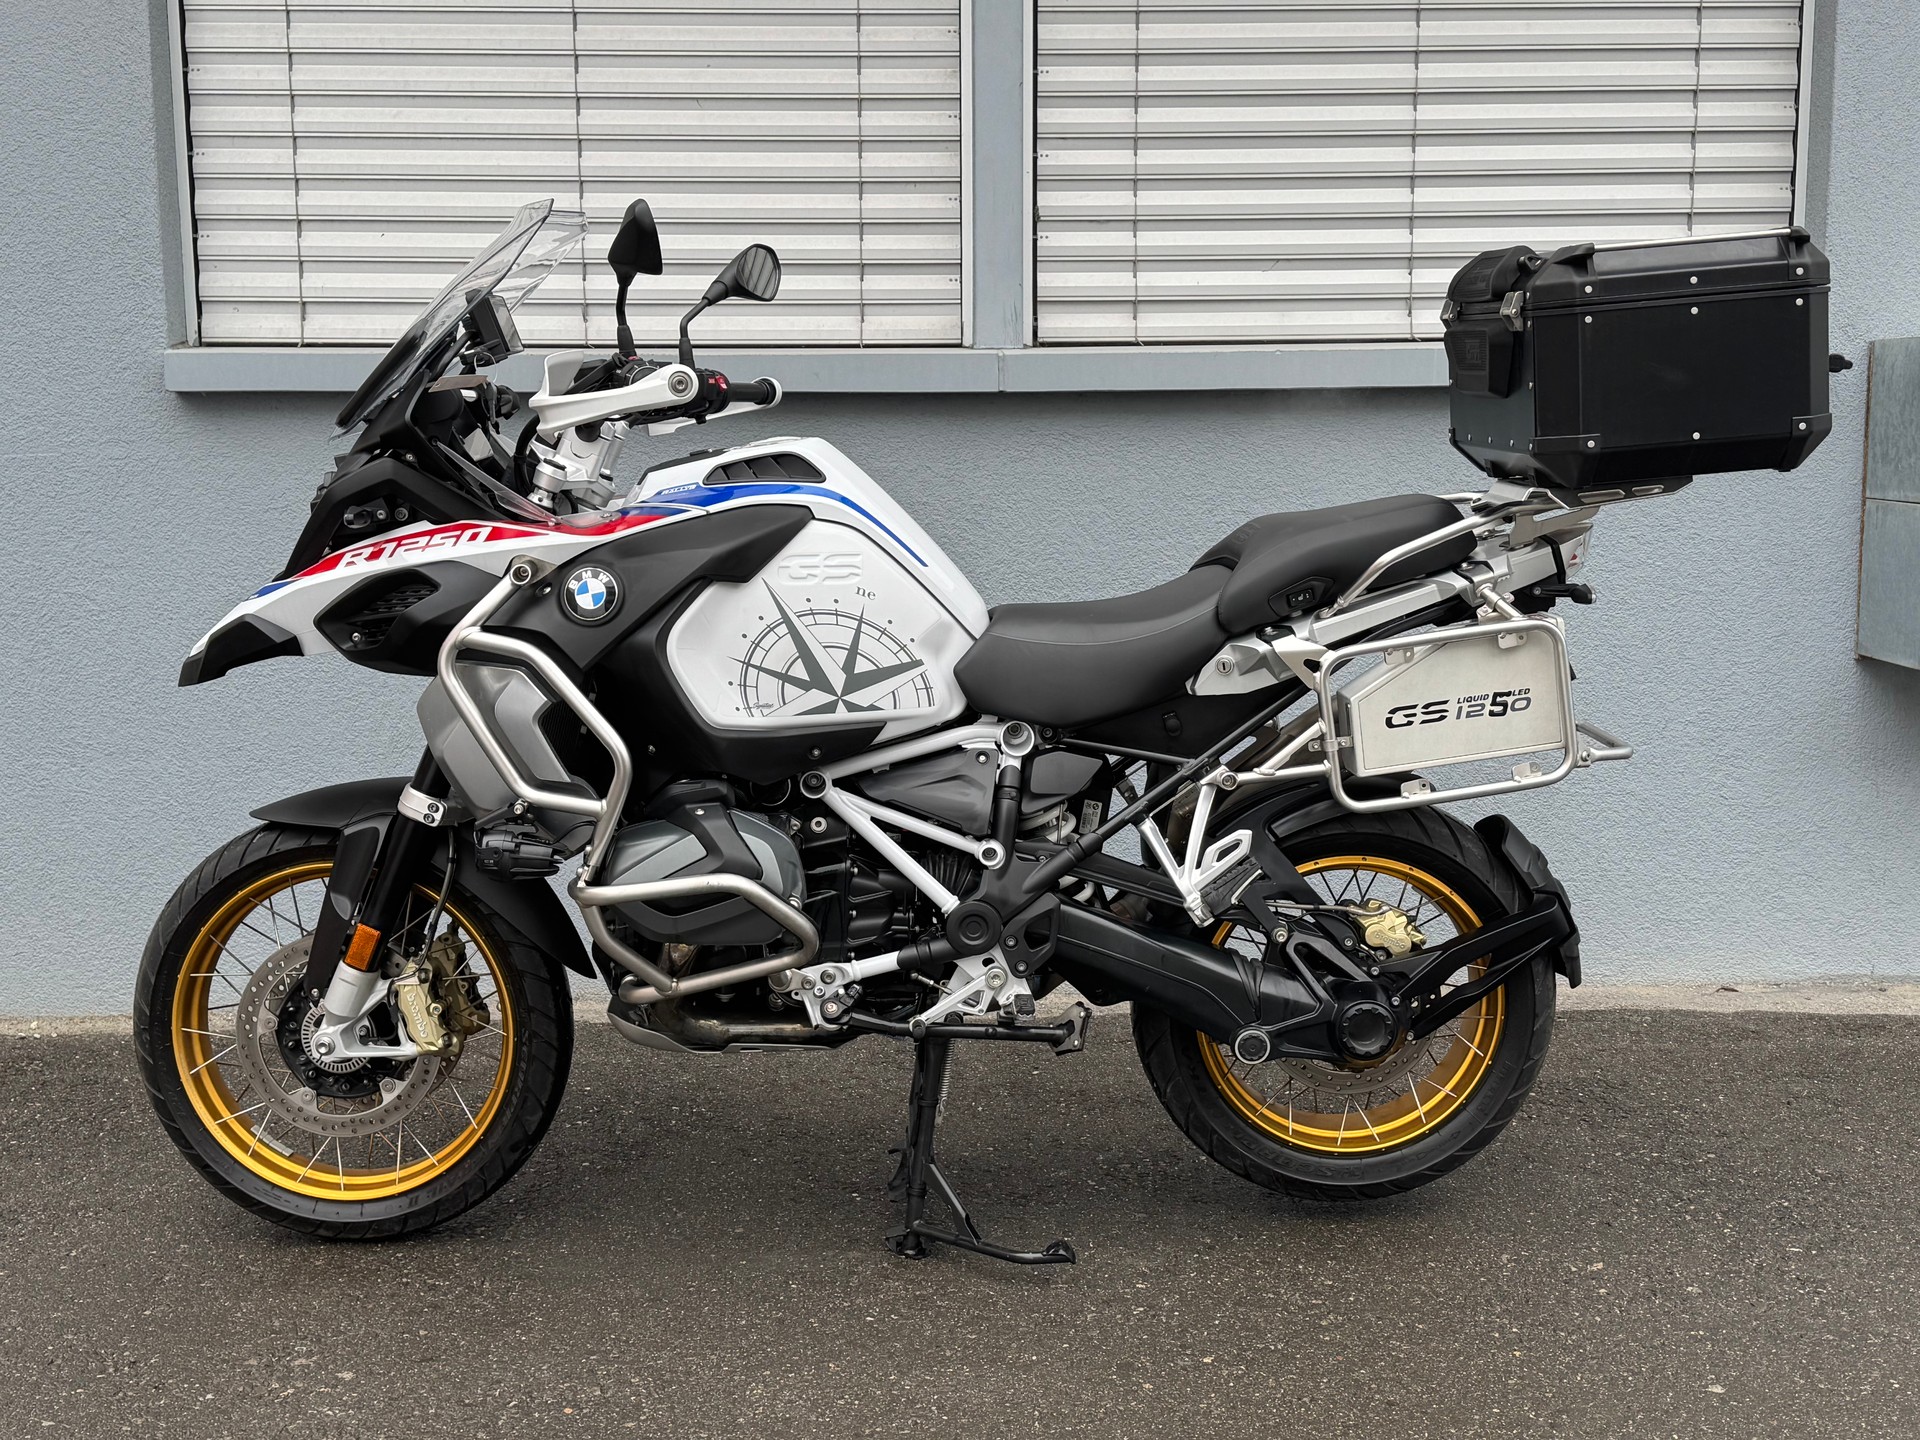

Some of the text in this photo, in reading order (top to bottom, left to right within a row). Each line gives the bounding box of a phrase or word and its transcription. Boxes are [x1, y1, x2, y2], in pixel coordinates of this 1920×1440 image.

[568, 570, 610, 590] BMW
[777, 552, 862, 586] GS
[1385, 691, 1532, 729] GS 1250
[1457, 693, 1490, 704] LIQUID
[1374, 931, 1406, 950] brembo
[406, 992, 428, 1039] brembo
